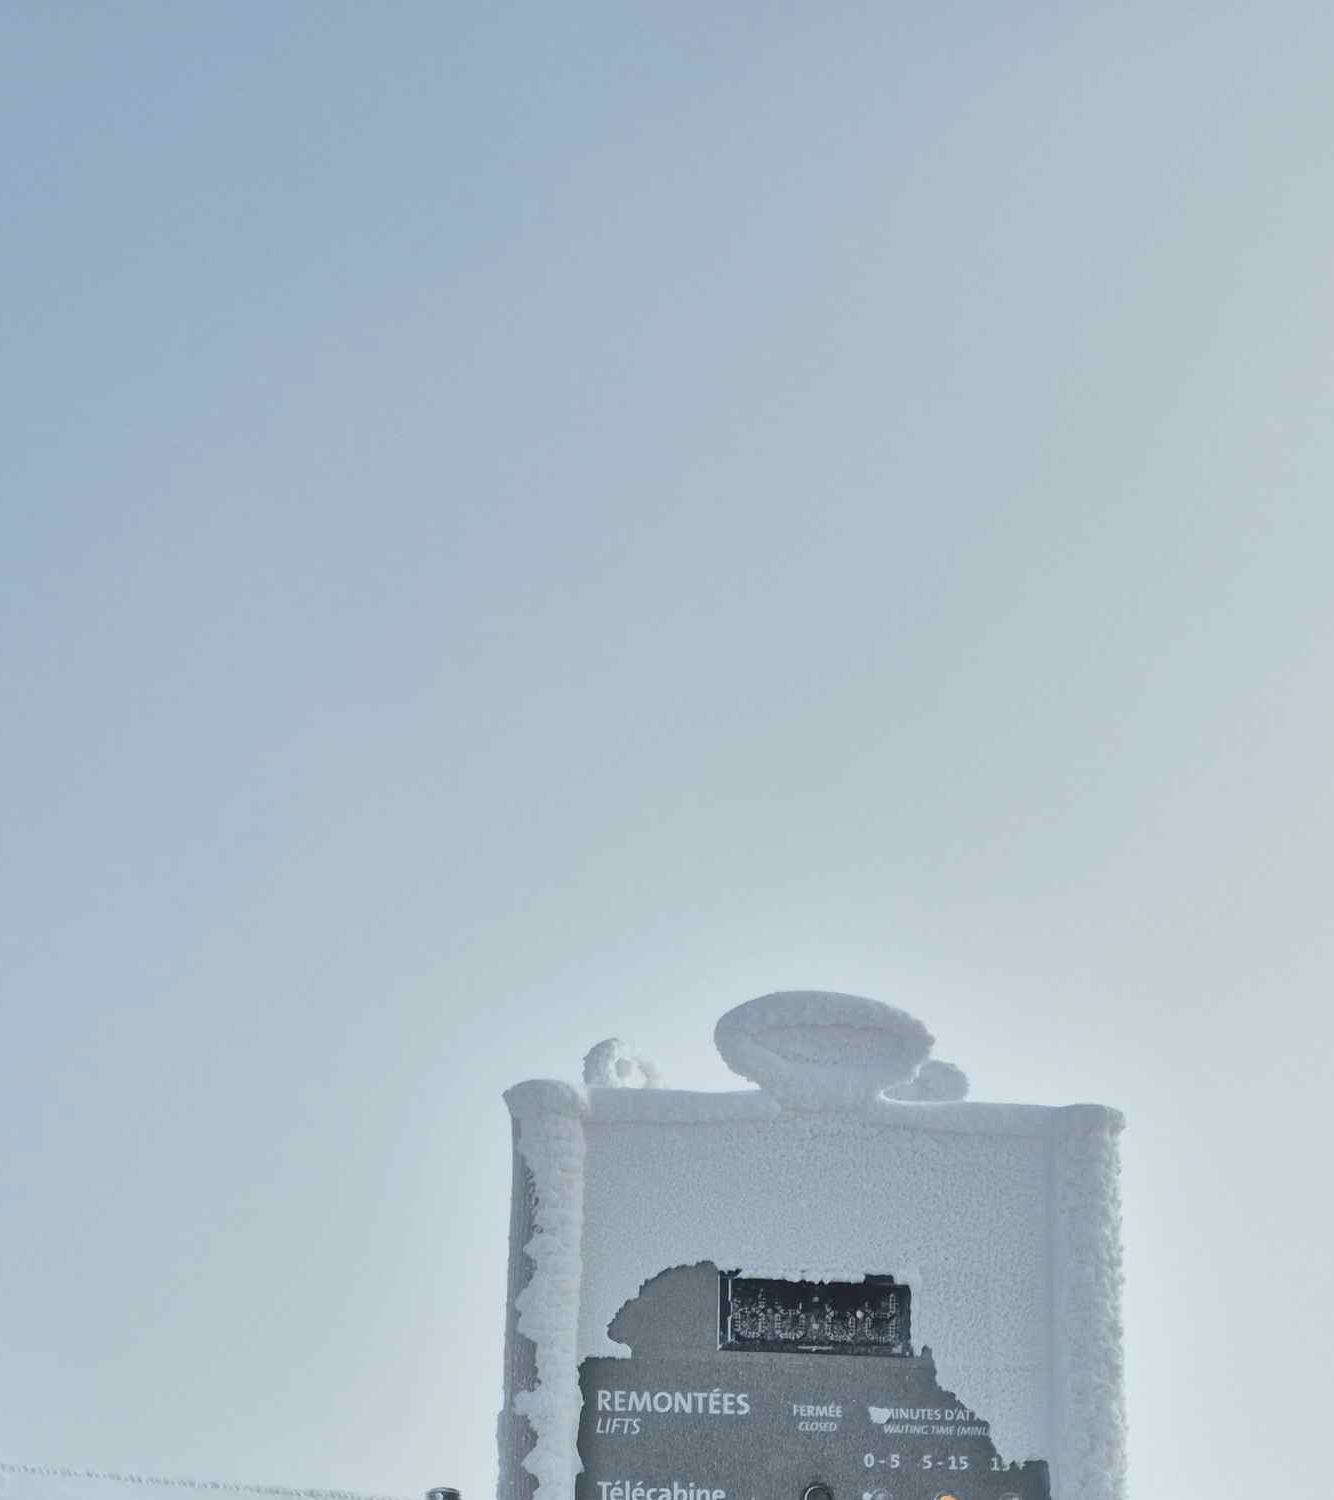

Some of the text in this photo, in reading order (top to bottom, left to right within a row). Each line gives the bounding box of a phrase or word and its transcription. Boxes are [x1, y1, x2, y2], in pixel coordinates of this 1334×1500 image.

[596, 1388, 751, 1415] REMONTÉES
[792, 1401, 844, 1418] FERMÉE
[595, 1417, 642, 1435] LIFTS
[797, 1421, 838, 1433] CLOSED
[883, 1423, 929, 1436] WAITING
[864, 1452, 875, 1469] 0
[890, 1453, 900, 1469] 5
[922, 1454, 933, 1470] 5
[947, 1455, 969, 1471] 15
